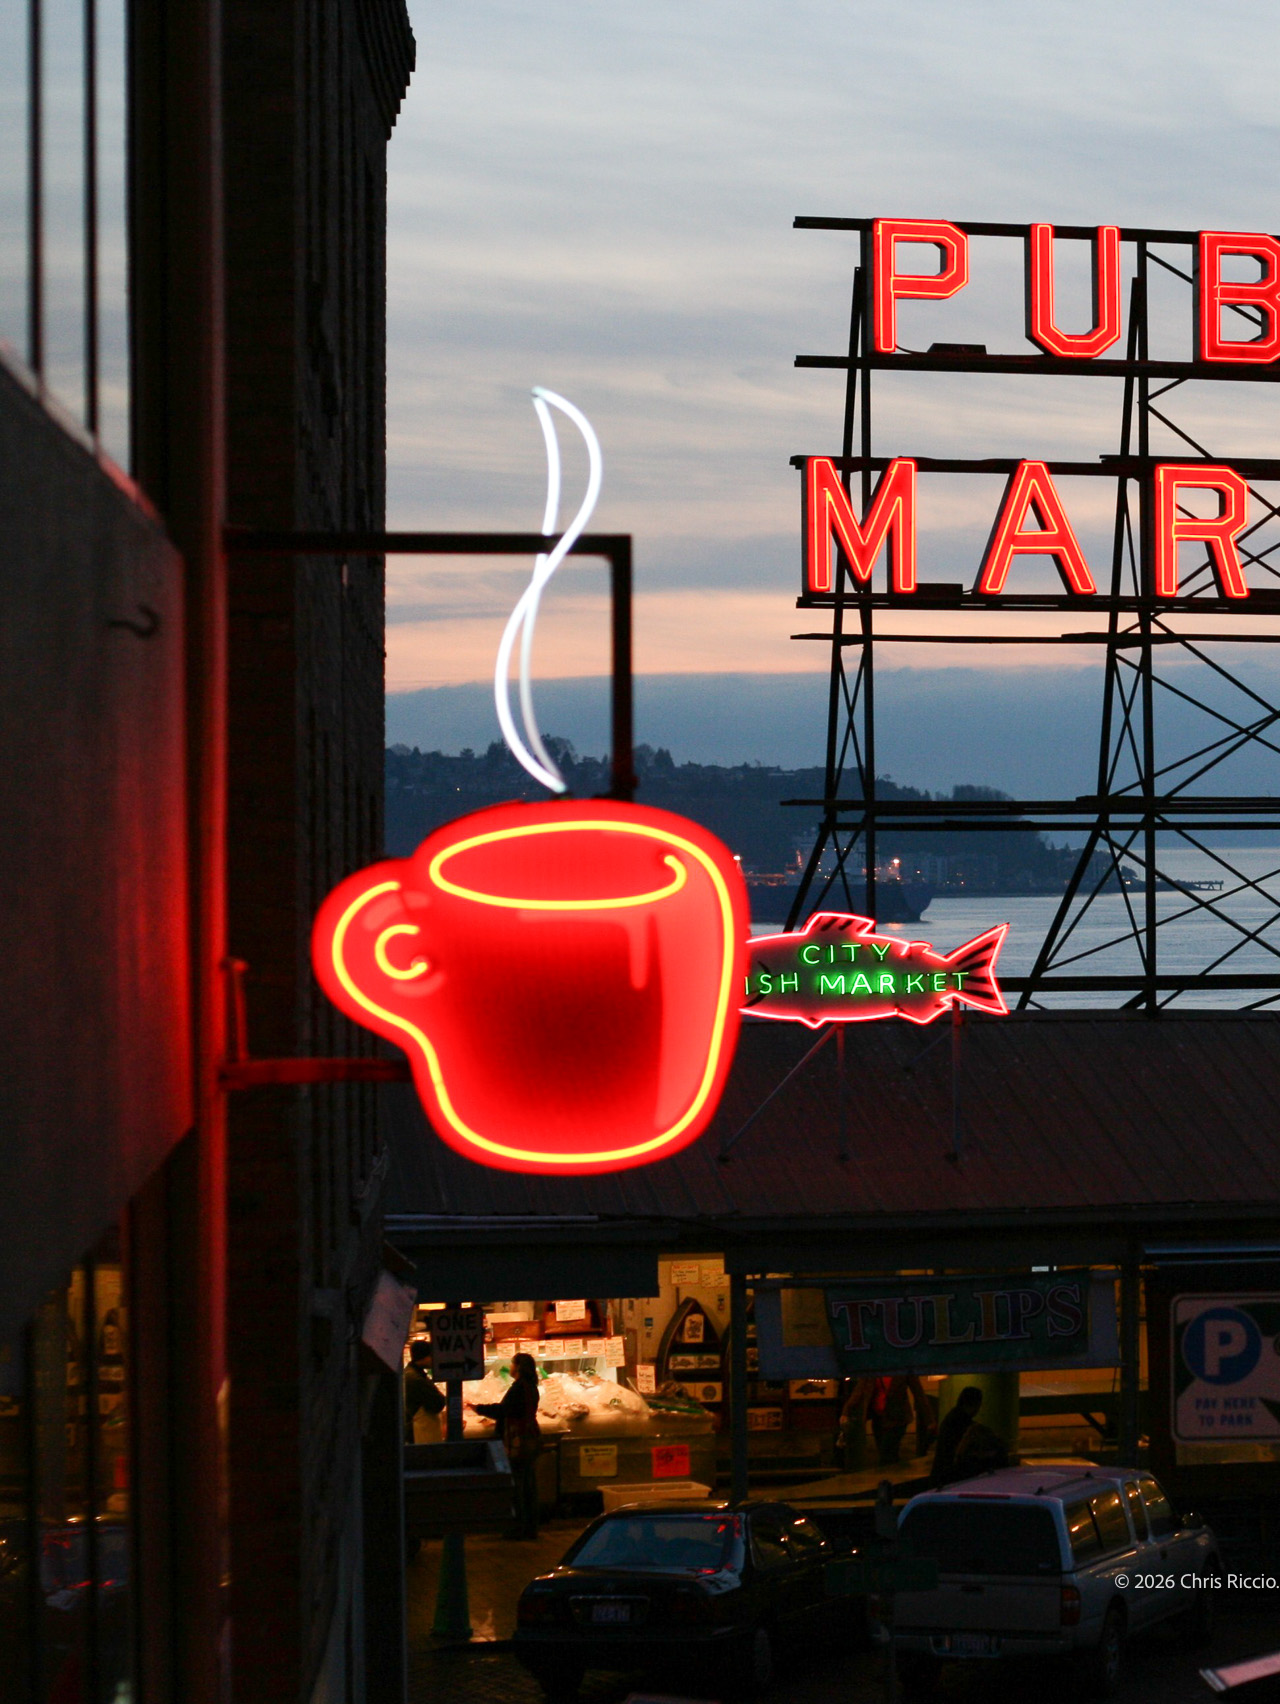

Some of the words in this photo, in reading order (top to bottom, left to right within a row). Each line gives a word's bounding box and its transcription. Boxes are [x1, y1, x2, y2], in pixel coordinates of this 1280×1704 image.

[802, 943, 891, 965] CITY
[744, 972, 799, 995] ISH
[819, 972, 970, 995] MARKET
[435, 1314, 477, 1332] ONE
[831, 1284, 1083, 1351] TULIPS
[436, 1335, 478, 1353] WAY
[1203, 1319, 1248, 1376] P
[1199, 1415, 1214, 1427] TO
[1220, 1414, 1253, 1426] PARK
